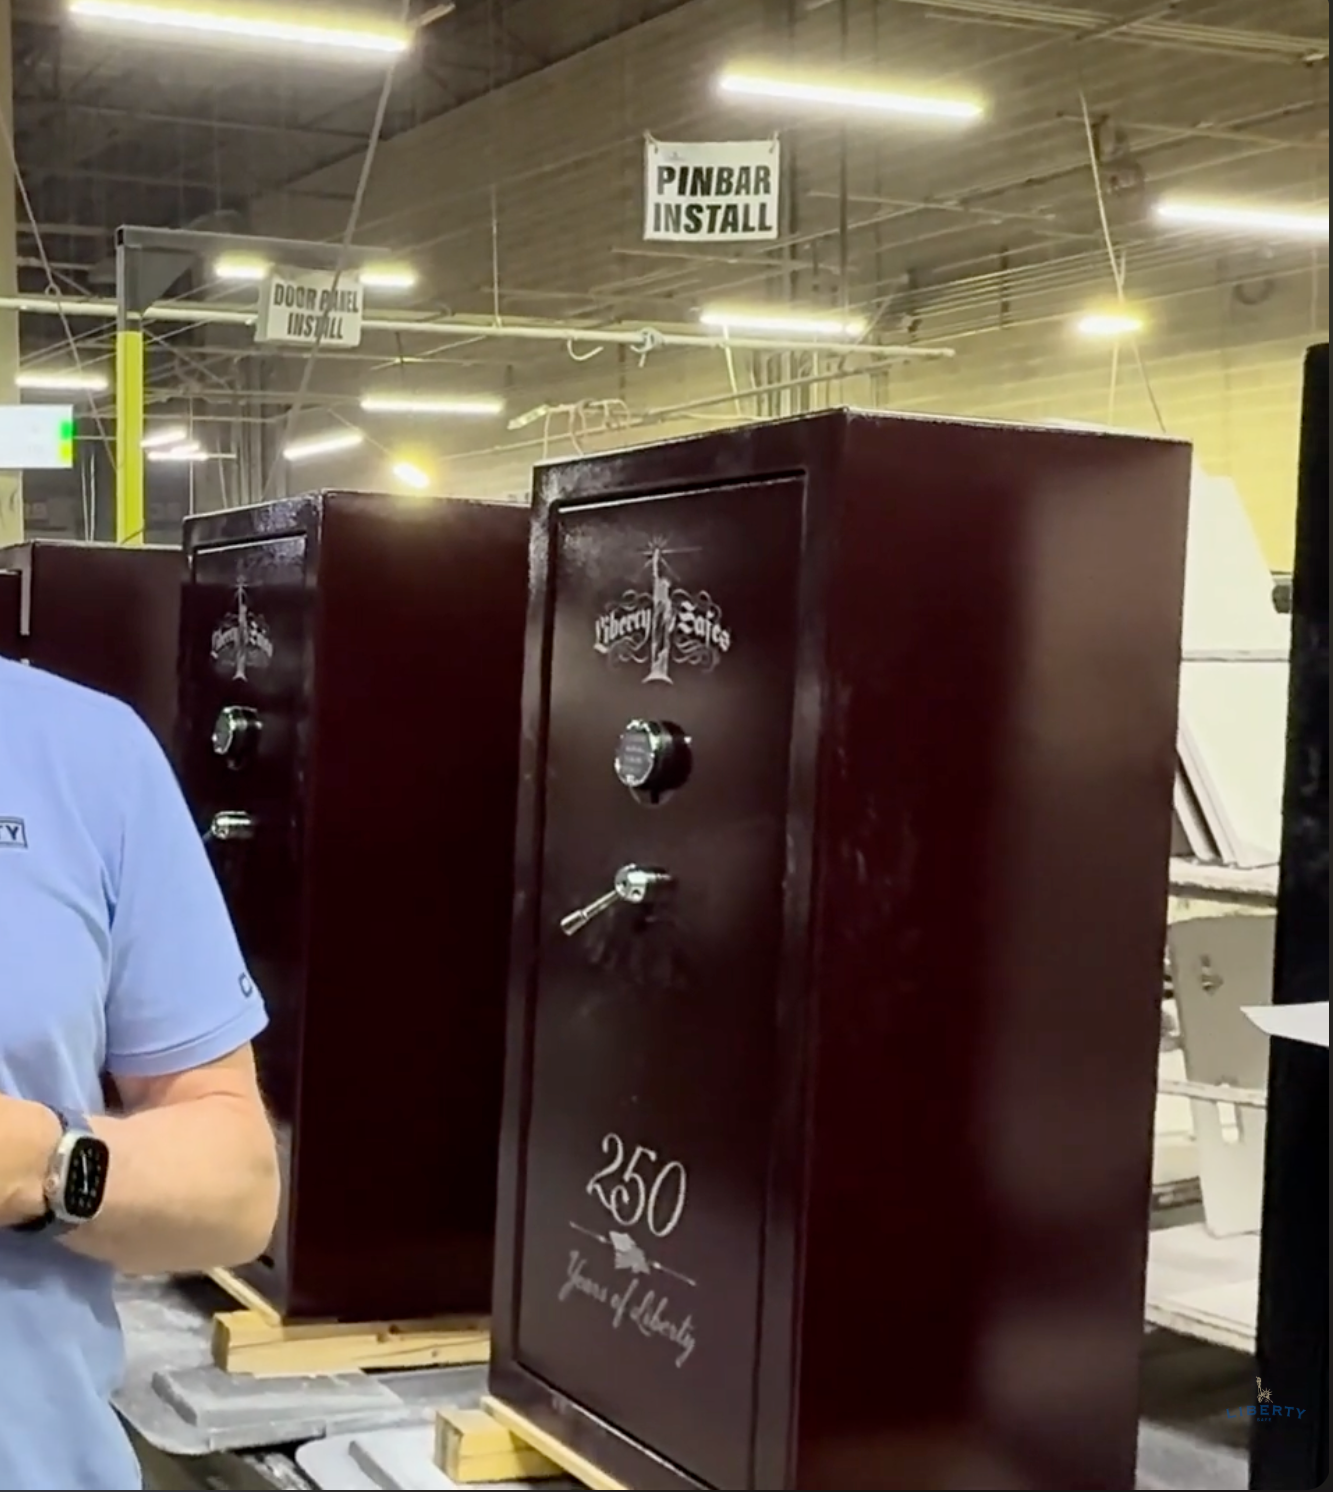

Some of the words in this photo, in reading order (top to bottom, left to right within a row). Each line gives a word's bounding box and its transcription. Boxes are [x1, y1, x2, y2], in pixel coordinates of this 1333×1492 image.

[657, 165, 771, 196] PINBAR
[653, 202, 773, 234] INSTALL
[273, 283, 318, 310] DOOR
[585, 1132, 687, 1238] 250
[558, 1249, 609, 1303] Years
[610, 1277, 640, 1330] of
[630, 1289, 697, 1369] Liberty
